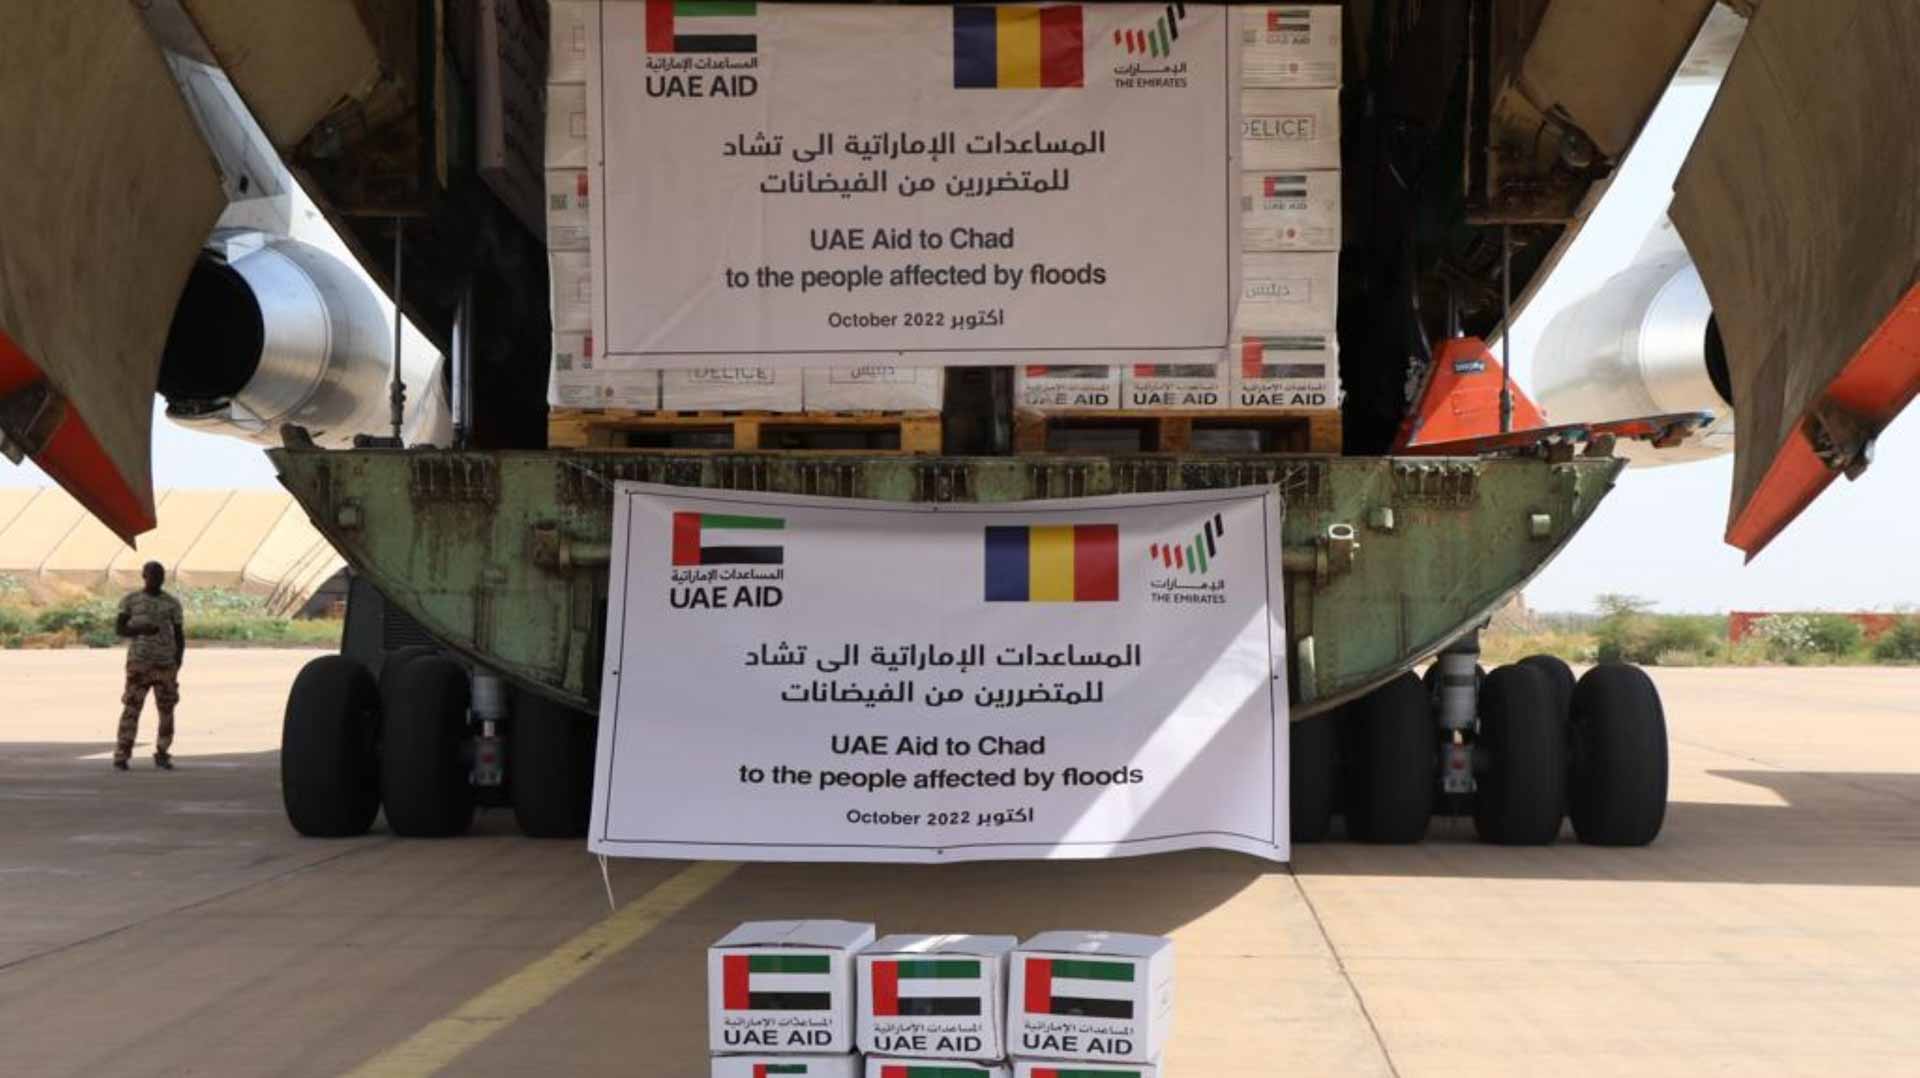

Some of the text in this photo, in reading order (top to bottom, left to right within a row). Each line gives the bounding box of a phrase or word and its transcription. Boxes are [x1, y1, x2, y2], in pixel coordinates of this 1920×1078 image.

[646, 75, 758, 97] UAE AID
[1115, 78, 1187, 88] THE EMIRATES
[723, 131, 1105, 162] المساعدات الإماراتية الى تشاد
[760, 168, 1069, 198] للمتضررين من الفيضانات
[810, 227, 1015, 250] UAE Aid to Chad
[726, 262, 1107, 292] to the people affected by floods
[828, 309, 1004, 330] October 2022 اكتوبر
[1074, 393, 1109, 405] AID
[1133, 392, 1218, 405] UAE AID
[1242, 393, 1326, 406] UAE AID
[670, 585, 783, 608] UAE AID
[1151, 593, 1226, 604] THE EMIRATES
[745, 641, 1141, 672] المساعدات الإماراتية الى تشاد
[782, 680, 1103, 709] للمتضررين من الفيضانات
[831, 735, 1045, 756] UAE Aid to Chad
[739, 764, 1143, 793] to the people affected by floods
[846, 807, 1034, 828] October 2022 اكتوبر
[724, 1029, 832, 1046] UAE AID
[874, 1035, 982, 1052] UAE AID
[1023, 1033, 1133, 1055] UAE AID
